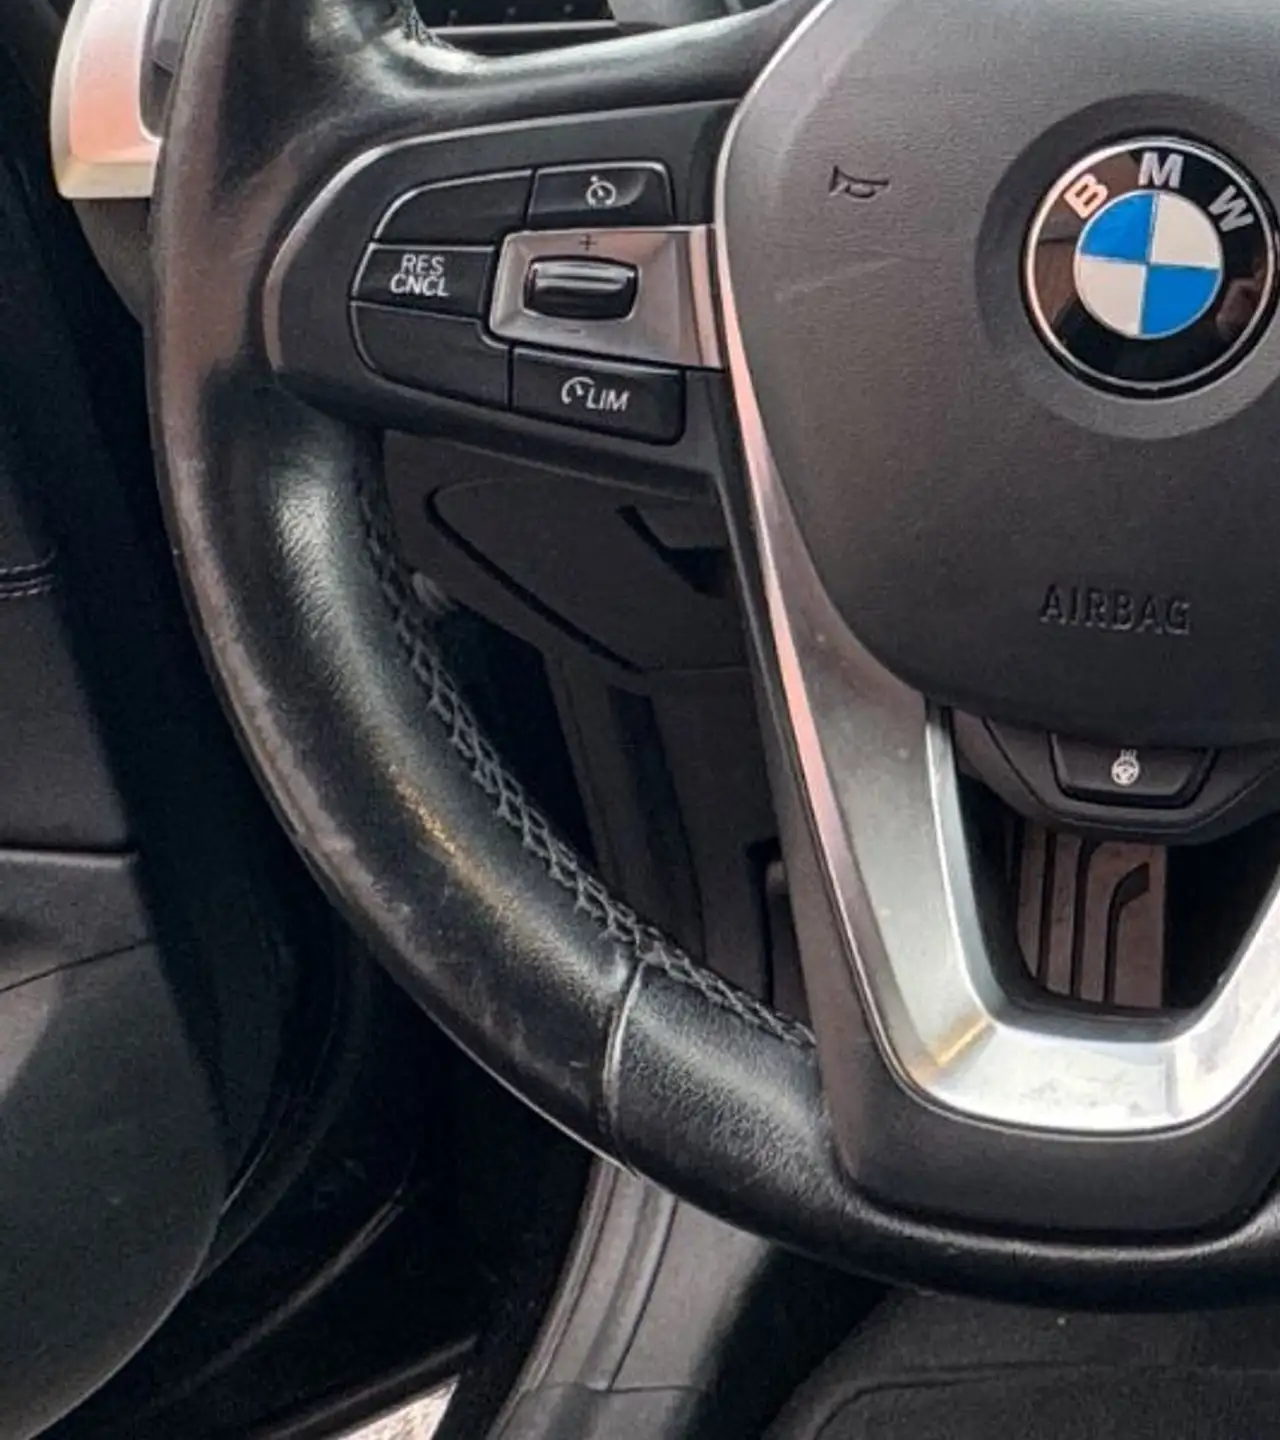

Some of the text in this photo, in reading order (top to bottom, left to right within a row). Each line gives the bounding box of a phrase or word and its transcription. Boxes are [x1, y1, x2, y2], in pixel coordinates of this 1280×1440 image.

[1063, 151, 1256, 234] BMW
[401, 254, 445, 274] RES
[390, 273, 450, 297] CNCL
[586, 386, 631, 412] LIM
[1039, 582, 1192, 636] AIRBAG
